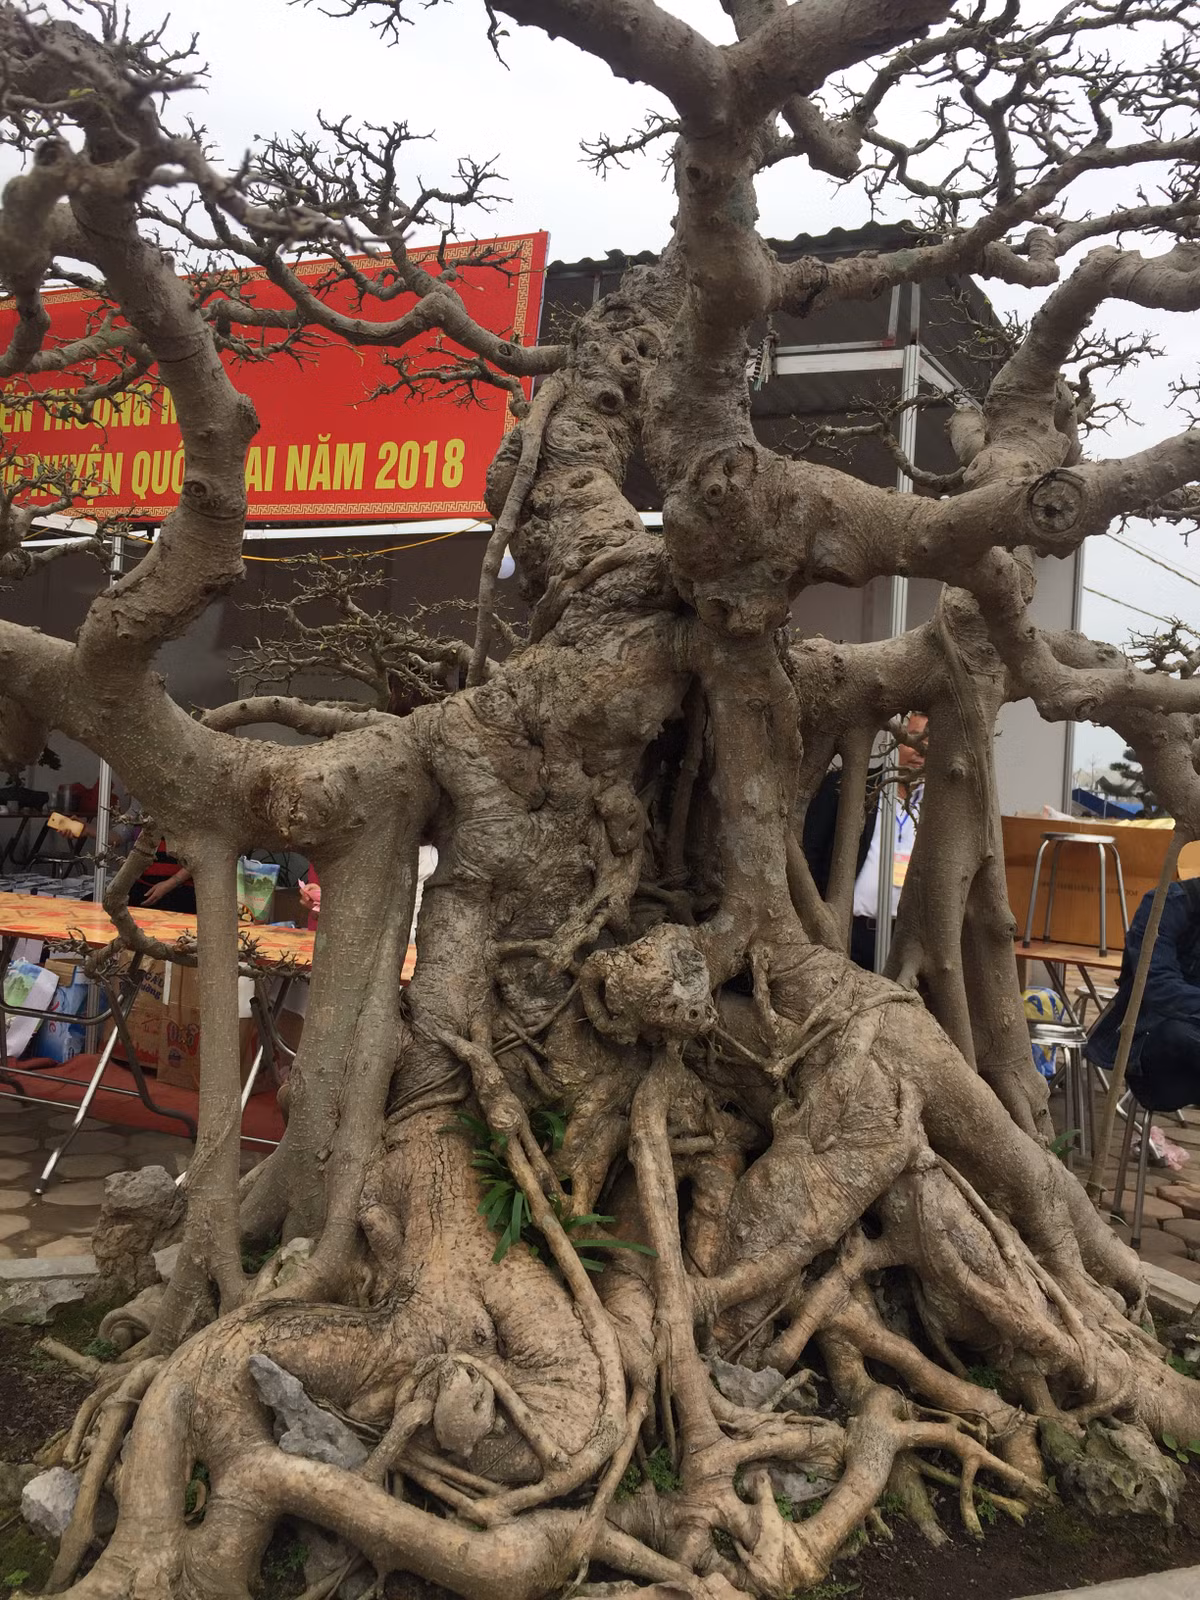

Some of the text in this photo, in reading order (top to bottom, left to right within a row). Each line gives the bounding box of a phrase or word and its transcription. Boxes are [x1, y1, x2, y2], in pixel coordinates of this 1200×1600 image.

[244, 445, 276, 492] AI
[284, 433, 367, 492] NĂM
[374, 438, 466, 490] 2018
